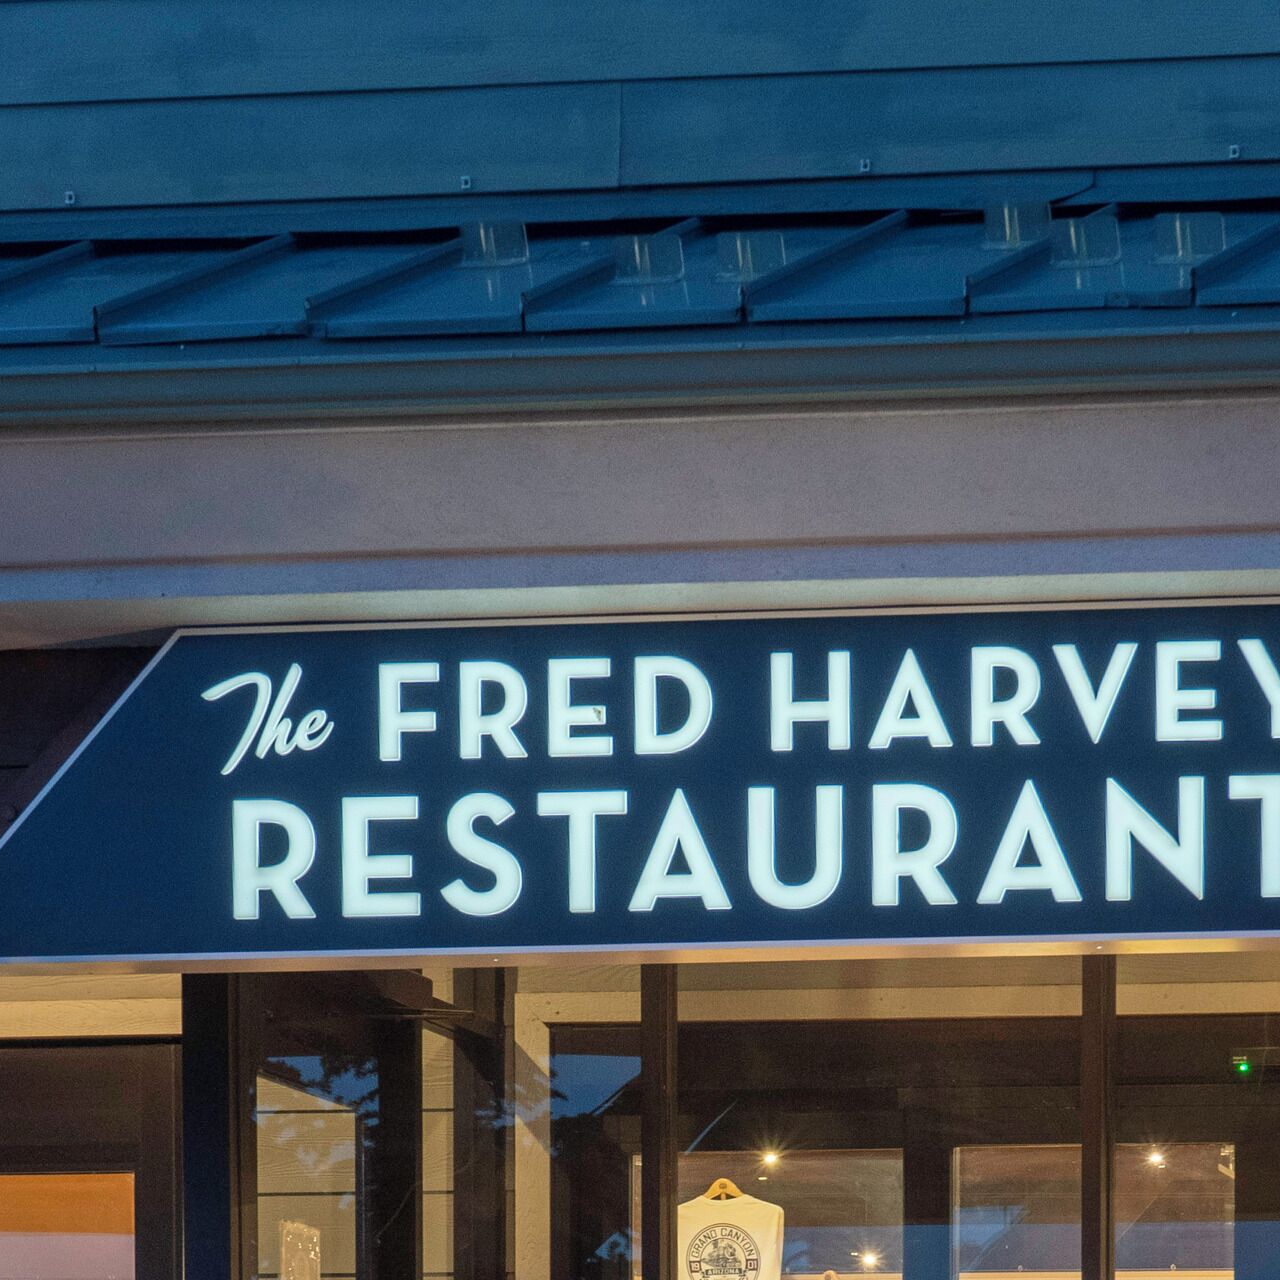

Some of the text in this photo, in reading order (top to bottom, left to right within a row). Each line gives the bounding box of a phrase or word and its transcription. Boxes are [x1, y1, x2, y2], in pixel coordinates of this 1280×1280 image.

[202, 662, 334, 776] The
[377, 655, 714, 761] FRED
[720, 1227, 755, 1257] CANYON
